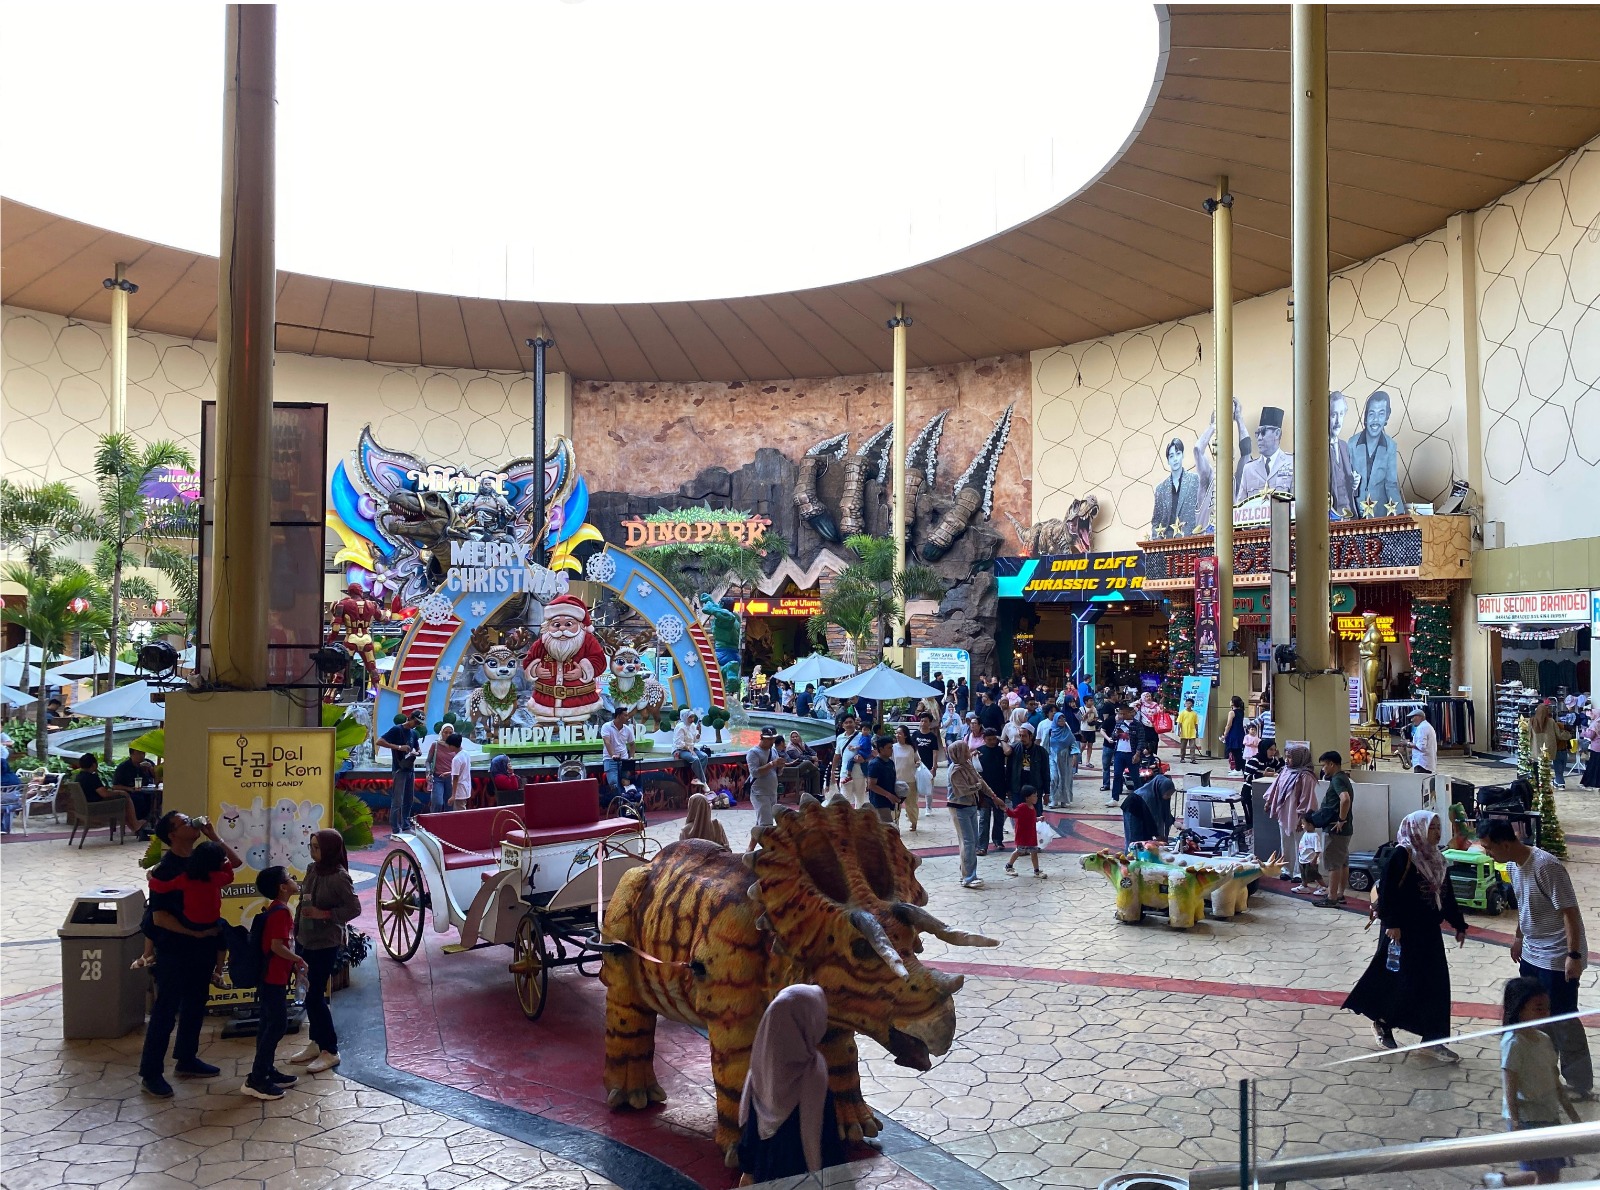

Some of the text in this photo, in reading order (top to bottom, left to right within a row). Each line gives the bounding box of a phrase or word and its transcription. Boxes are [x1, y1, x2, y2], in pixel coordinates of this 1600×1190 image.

[158, 474, 200, 483] MILENIA
[406, 464, 509, 496] Milenil
[1233, 505, 1271, 522] WELCO
[624, 521, 767, 547] DINO PARK
[450, 540, 531, 567] MERRY
[1329, 536, 1384, 568] TAR
[1050, 555, 1139, 572] DINO CAFE
[446, 567, 570, 595] CHRISTMAS
[1024, 578, 1100, 591] JURASSIC
[1105, 577, 1127, 589] 7D
[789, 607, 808, 615] Timur
[1479, 598, 1501, 614] BATU
[1503, 596, 1538, 613] SECOND
[1540, 593, 1587, 611] BRANDED
[1339, 618, 1365, 628] TIKET
[498, 724, 600, 747] HAPPY NEW
[222, 737, 269, 778] 달콤
[272, 745, 303, 762] Dal
[220, 884, 256, 897] Manis
[82, 949, 102, 960] M
[80, 960, 102, 981] 28
[208, 991, 239, 1001] AREA
